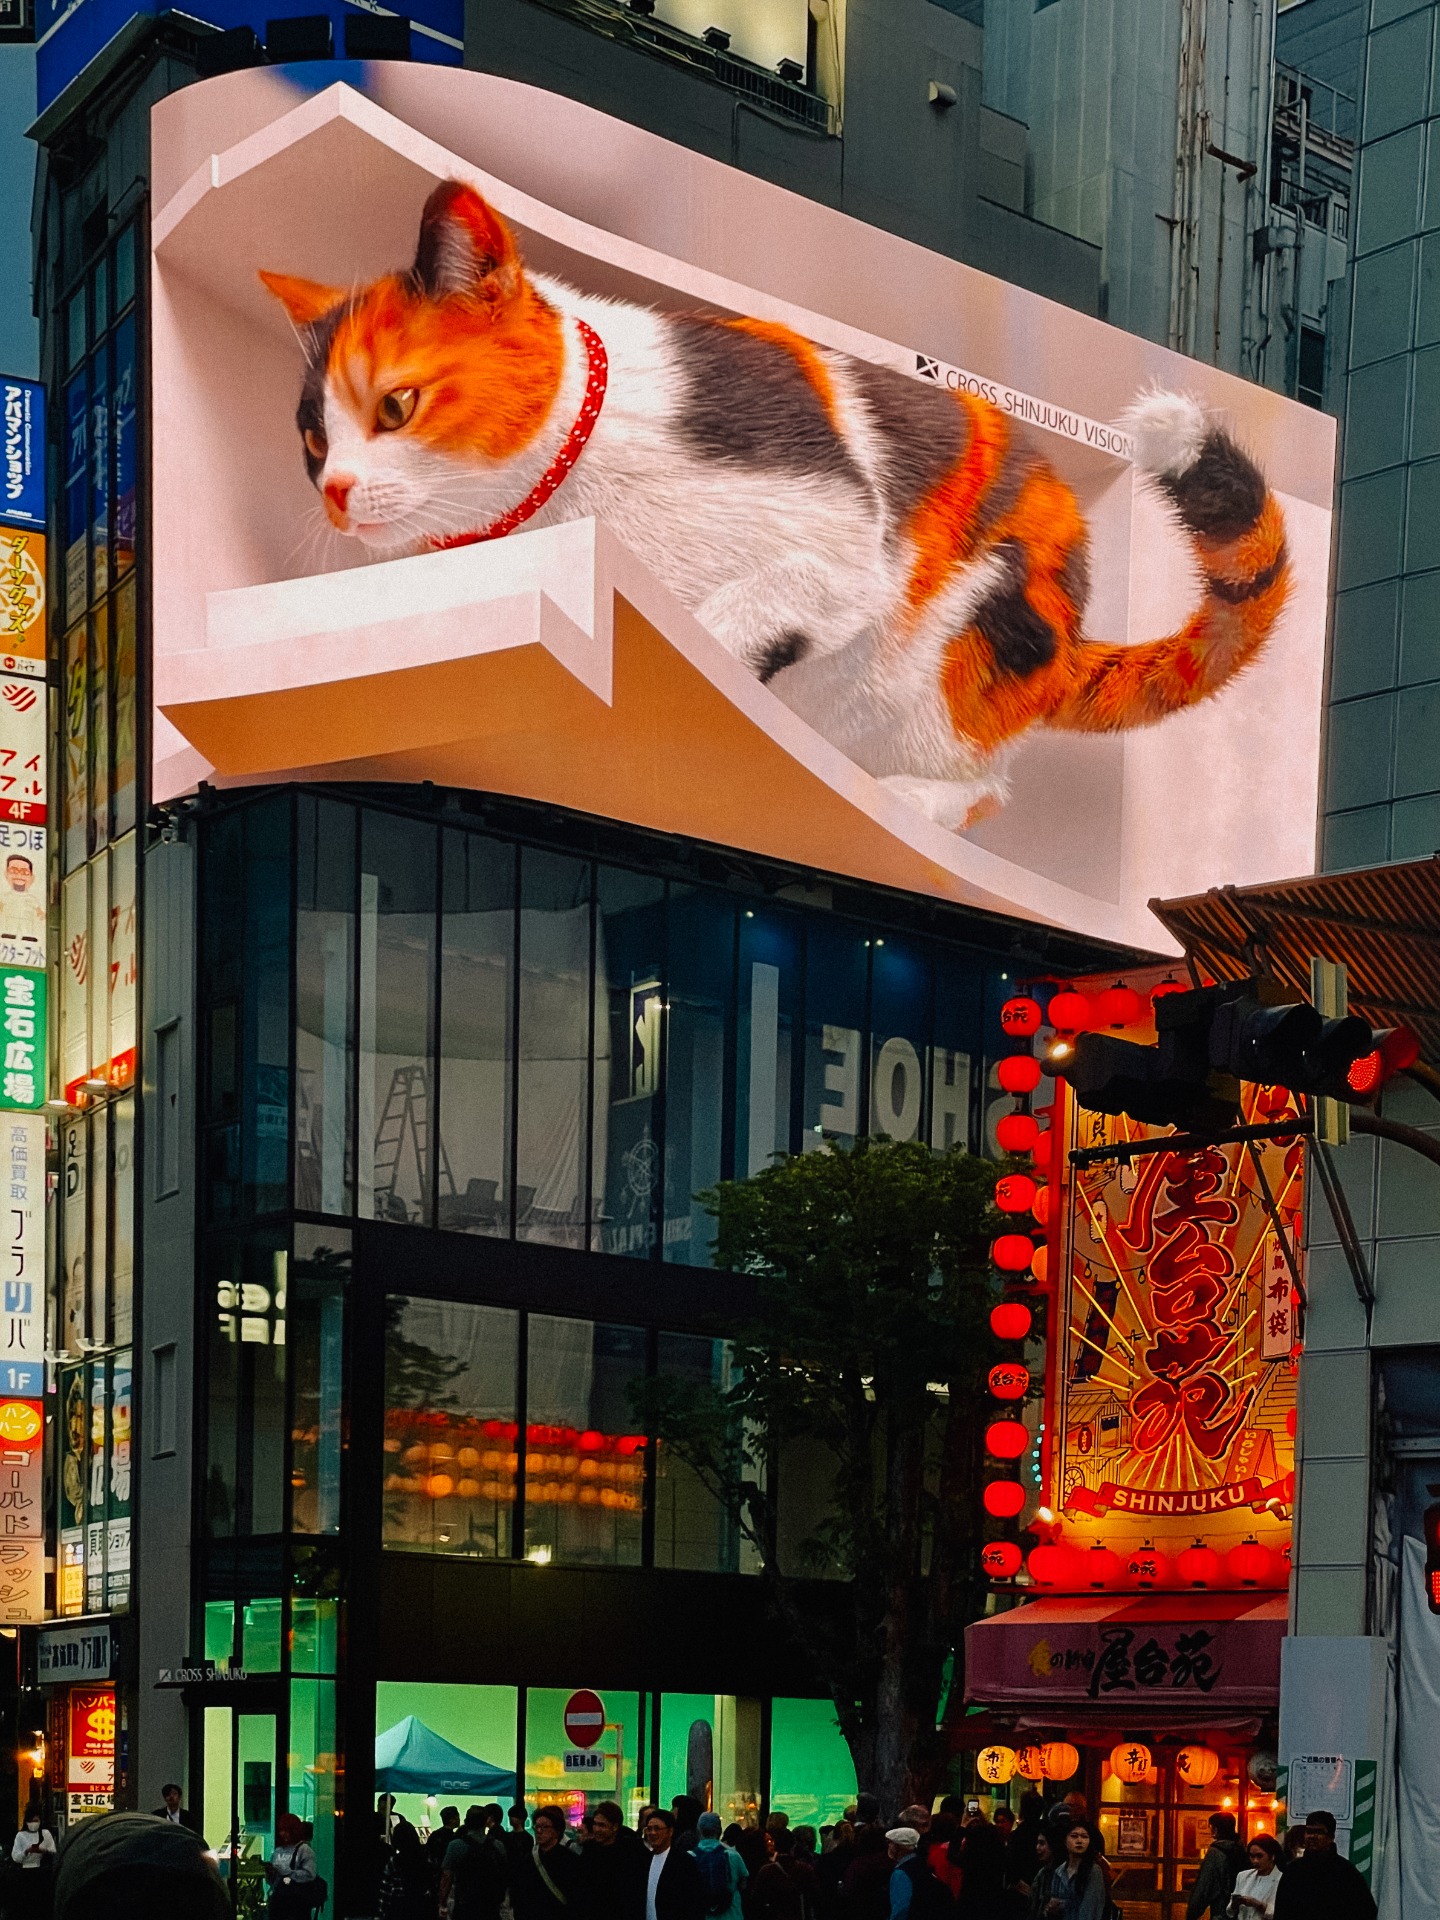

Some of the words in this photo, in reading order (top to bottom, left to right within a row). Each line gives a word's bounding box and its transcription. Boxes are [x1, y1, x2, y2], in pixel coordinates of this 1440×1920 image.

[946, 370, 997, 405] CROSS
[1004, 392, 1078, 436] SHINJUKU
[1085, 421, 1134, 457] VISION
[8, 801, 32, 820] 4F
[3, 975, 35, 1105] 宝石広場
[10, 1125, 28, 1202] 高価買取
[1266, 1276, 1289, 1338] 布袋
[7, 1368, 31, 1390] 1F
[1113, 1485, 1245, 1512] SHINJUKU
[175, 1663, 203, 1682] CROSS
[1087, 1627, 1222, 1699] 屋台苑
